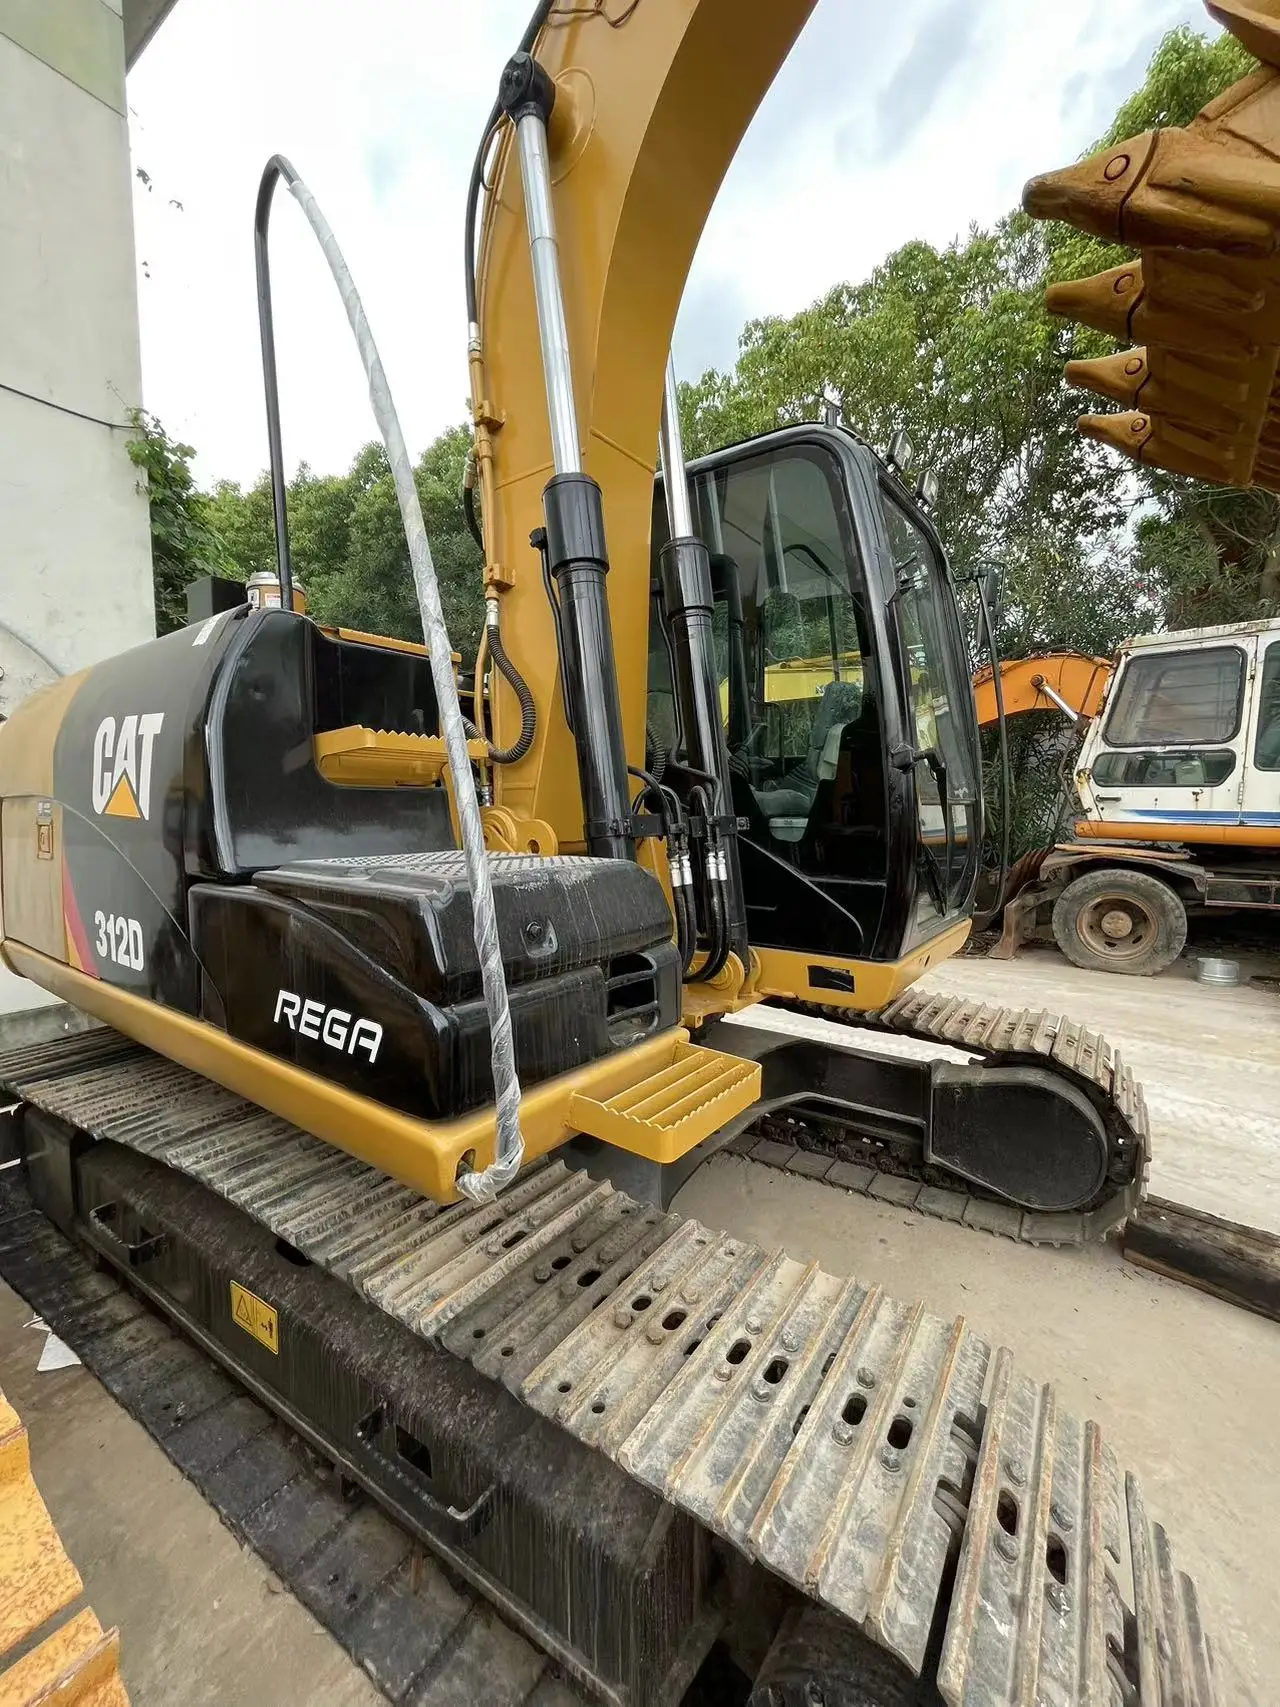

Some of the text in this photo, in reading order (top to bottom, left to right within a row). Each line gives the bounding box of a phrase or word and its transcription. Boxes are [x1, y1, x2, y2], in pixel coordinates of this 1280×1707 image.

[92, 712, 165, 821] CAT
[94, 910, 144, 971] 312D
[273, 989, 383, 1064] REGA
